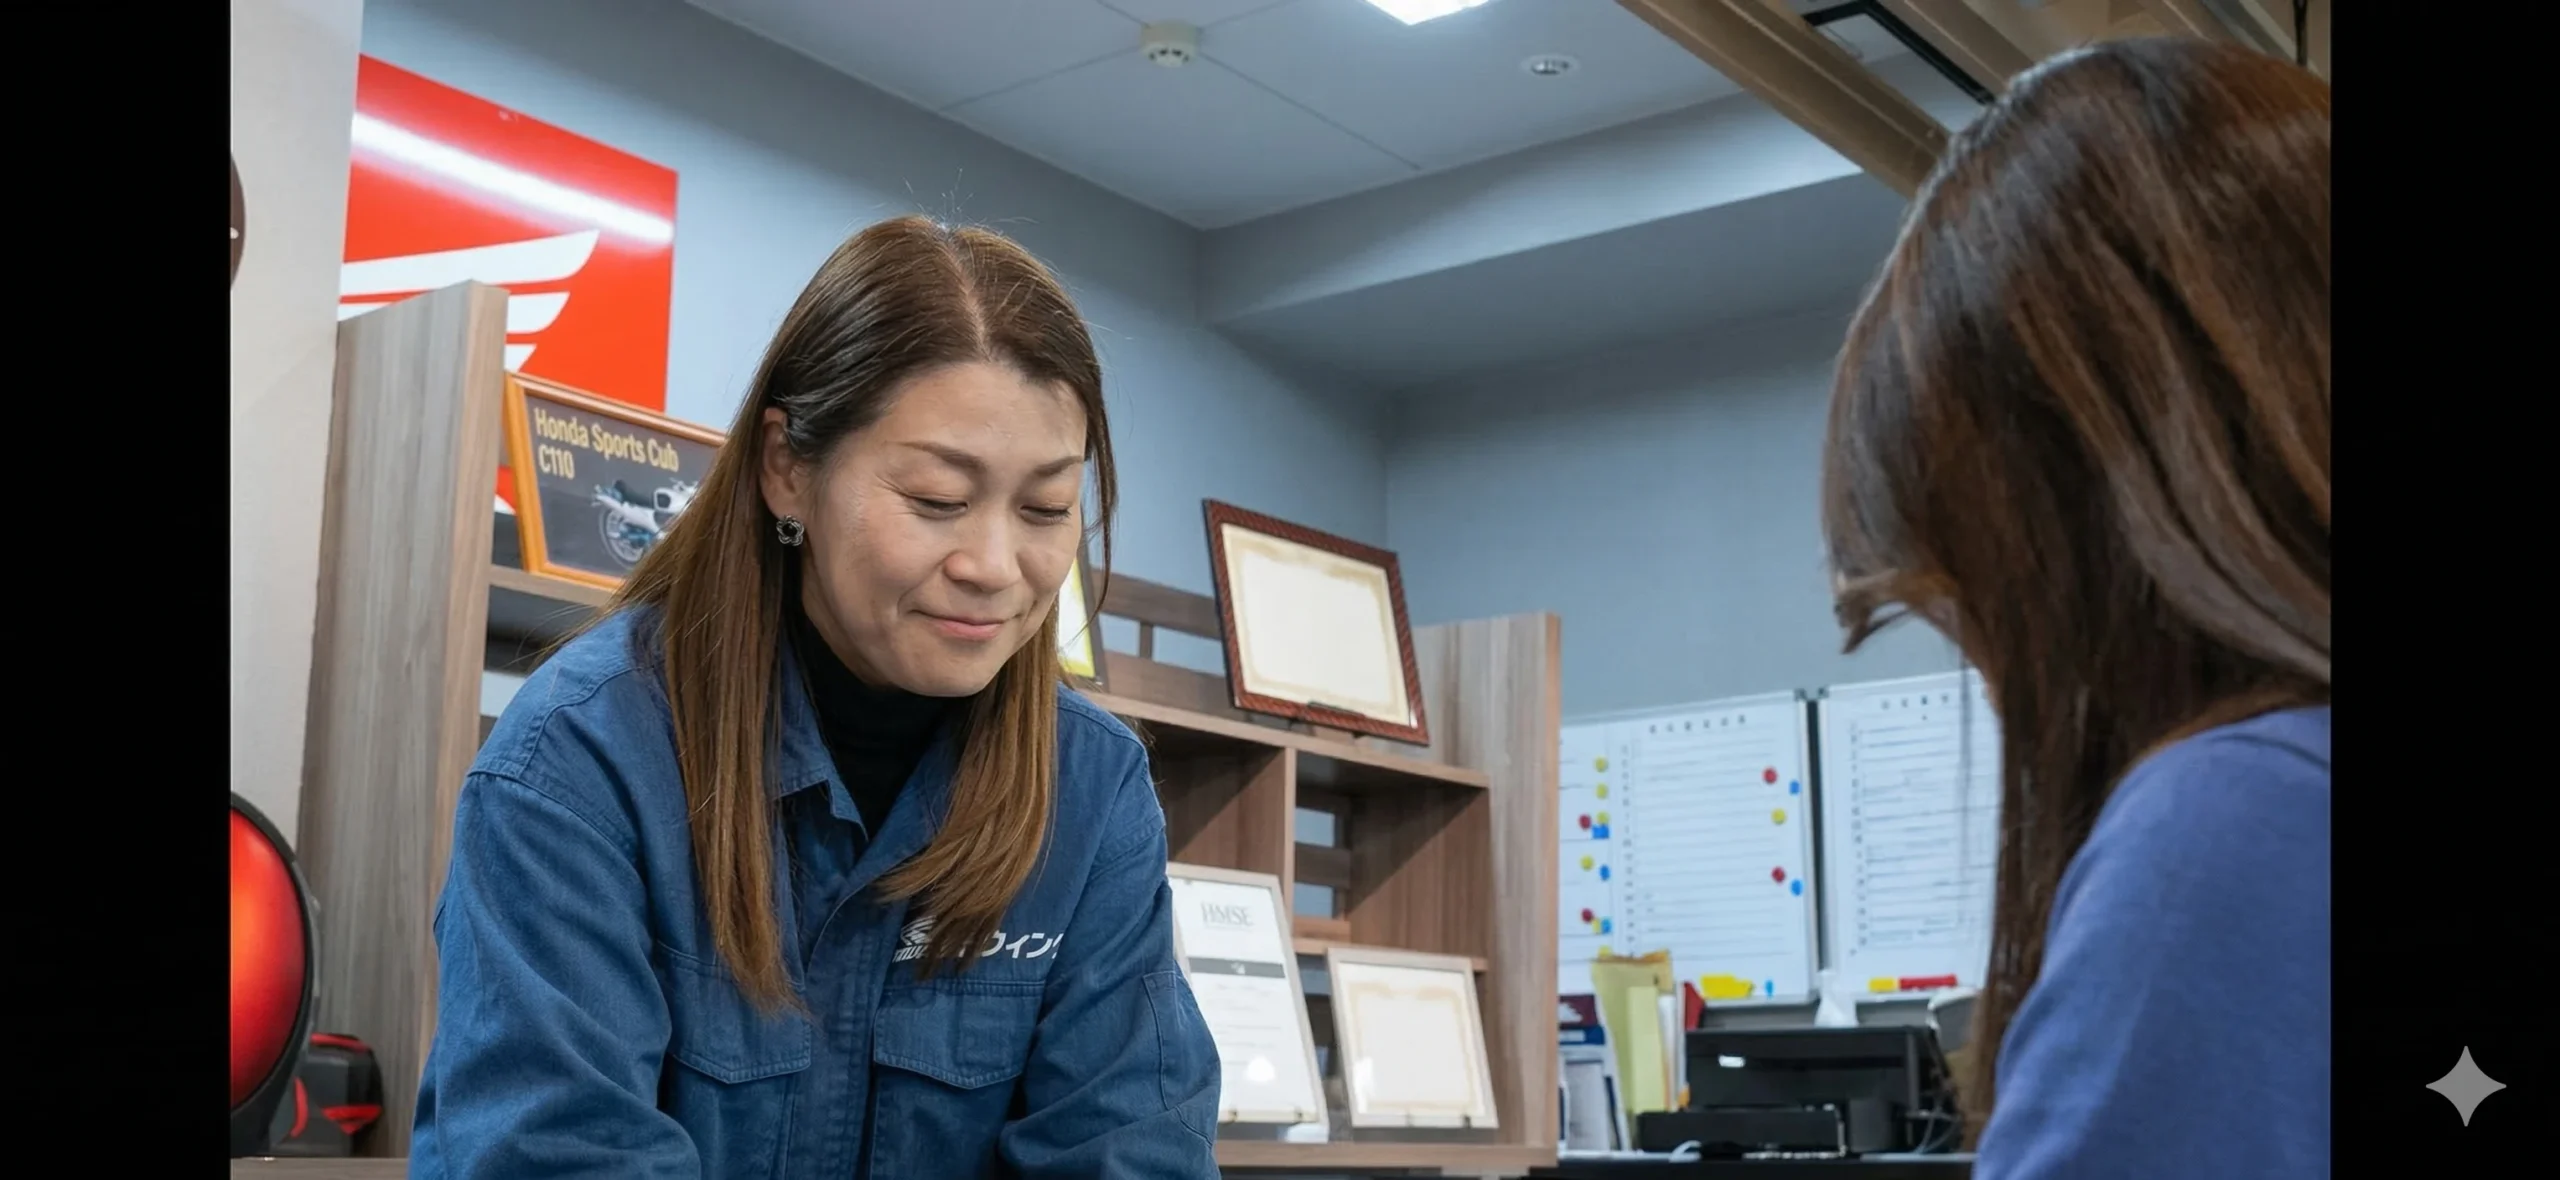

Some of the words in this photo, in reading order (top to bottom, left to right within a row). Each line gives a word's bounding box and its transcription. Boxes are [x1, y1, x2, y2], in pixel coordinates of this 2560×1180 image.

[534, 407, 589, 448] Honda
[592, 423, 646, 464] Sports
[648, 438, 679, 472] Cub
[538, 444, 575, 480] C110
